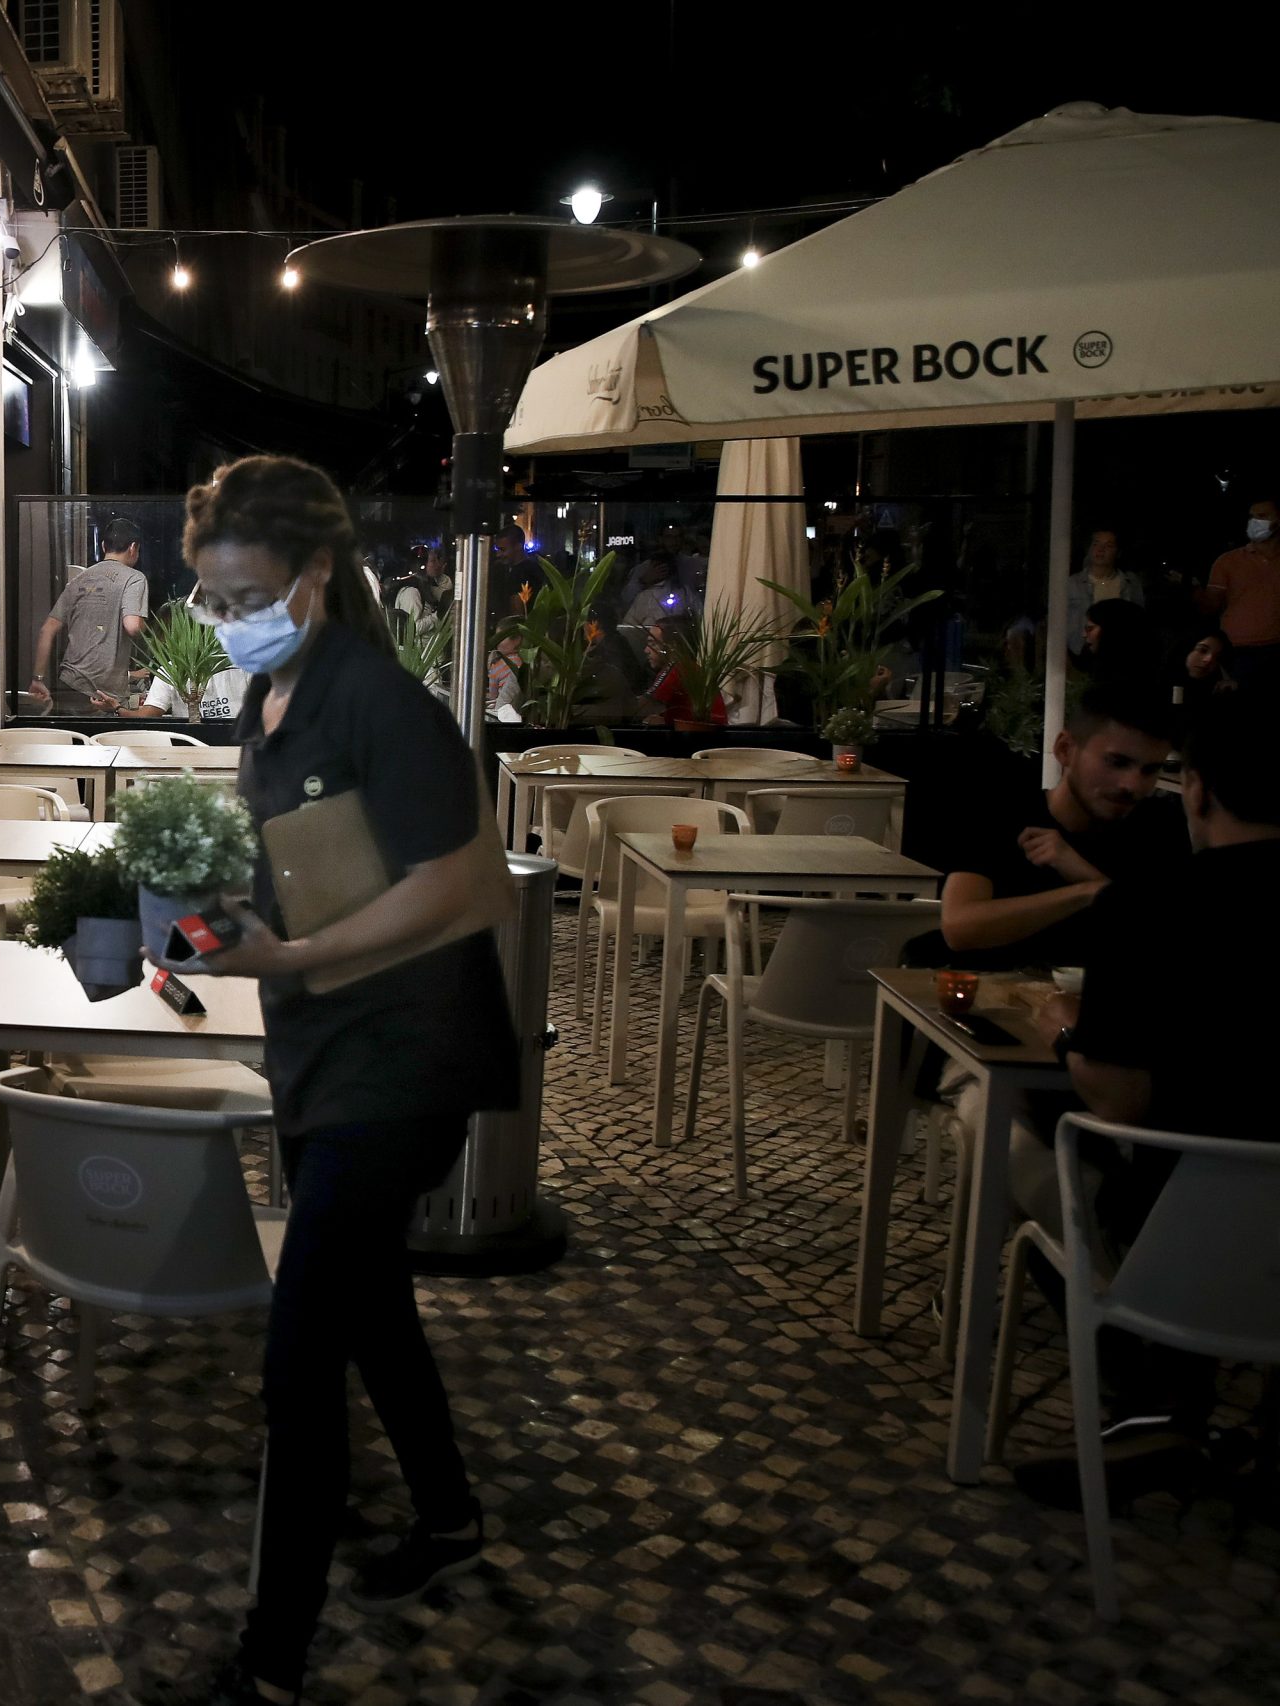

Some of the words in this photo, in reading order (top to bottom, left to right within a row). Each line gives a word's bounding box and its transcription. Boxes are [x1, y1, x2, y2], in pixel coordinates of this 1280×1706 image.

[1078, 340, 1107, 351] SUPER
[752, 348, 901, 395] SUPER
[913, 334, 1049, 383] BOCK
